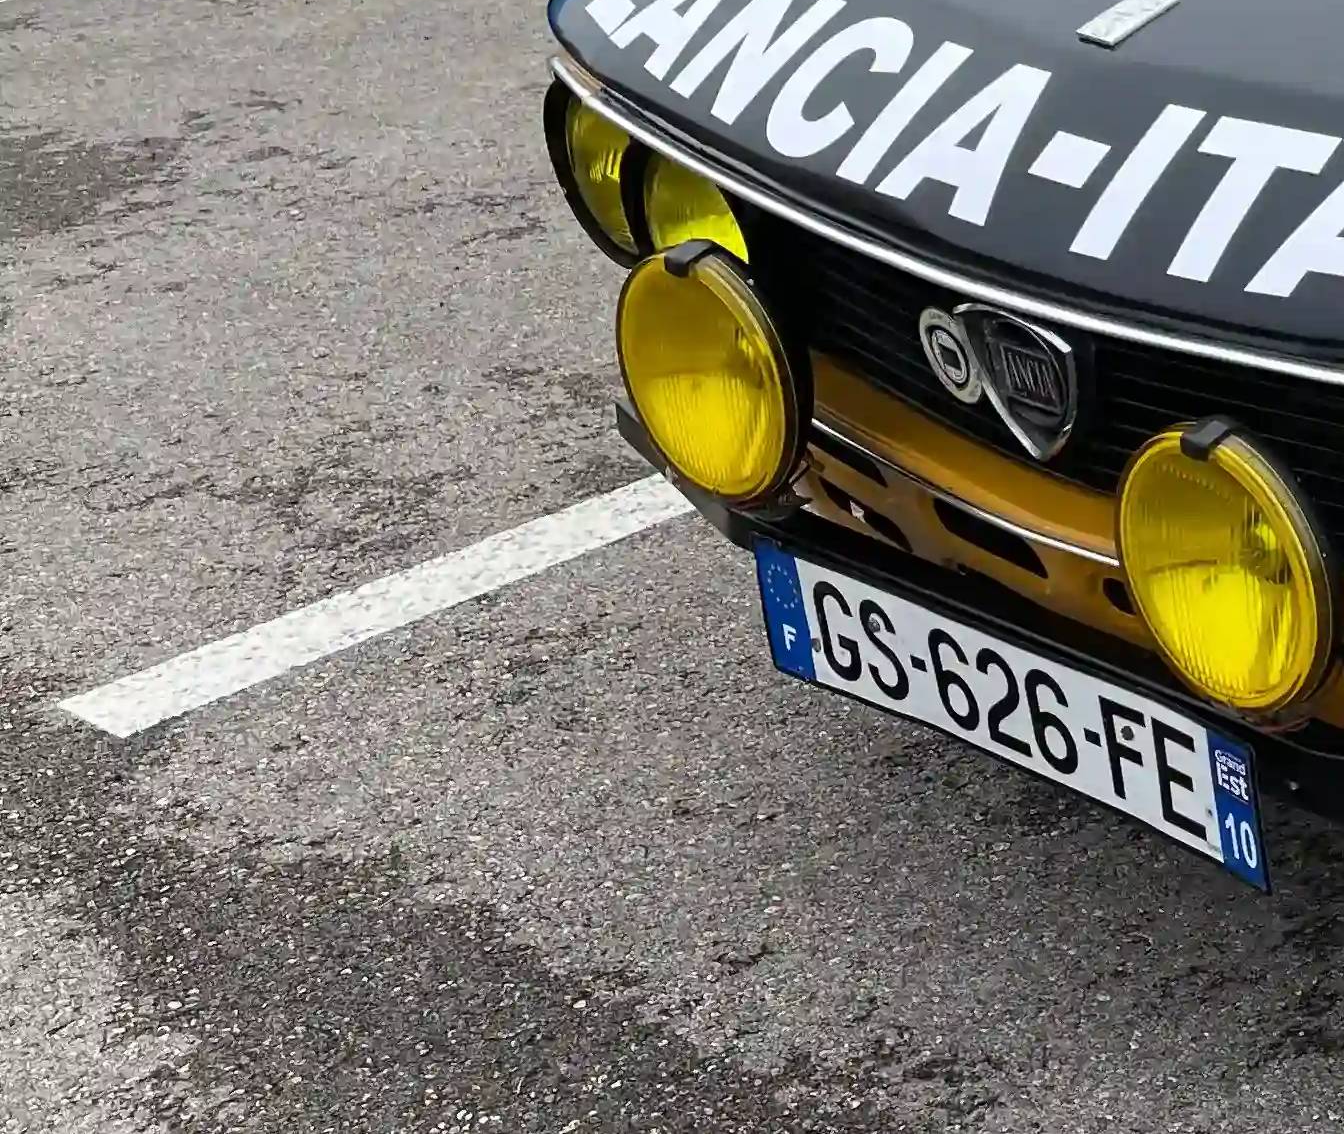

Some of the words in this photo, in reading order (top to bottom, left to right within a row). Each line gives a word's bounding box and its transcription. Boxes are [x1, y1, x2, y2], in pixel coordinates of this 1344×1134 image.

[782, 623, 797, 652] F
[813, 580, 1209, 843] GS-626-FE
[1214, 749, 1246, 776] Grand
[1215, 761, 1249, 801] Est
[1225, 812, 1258, 869] 10
